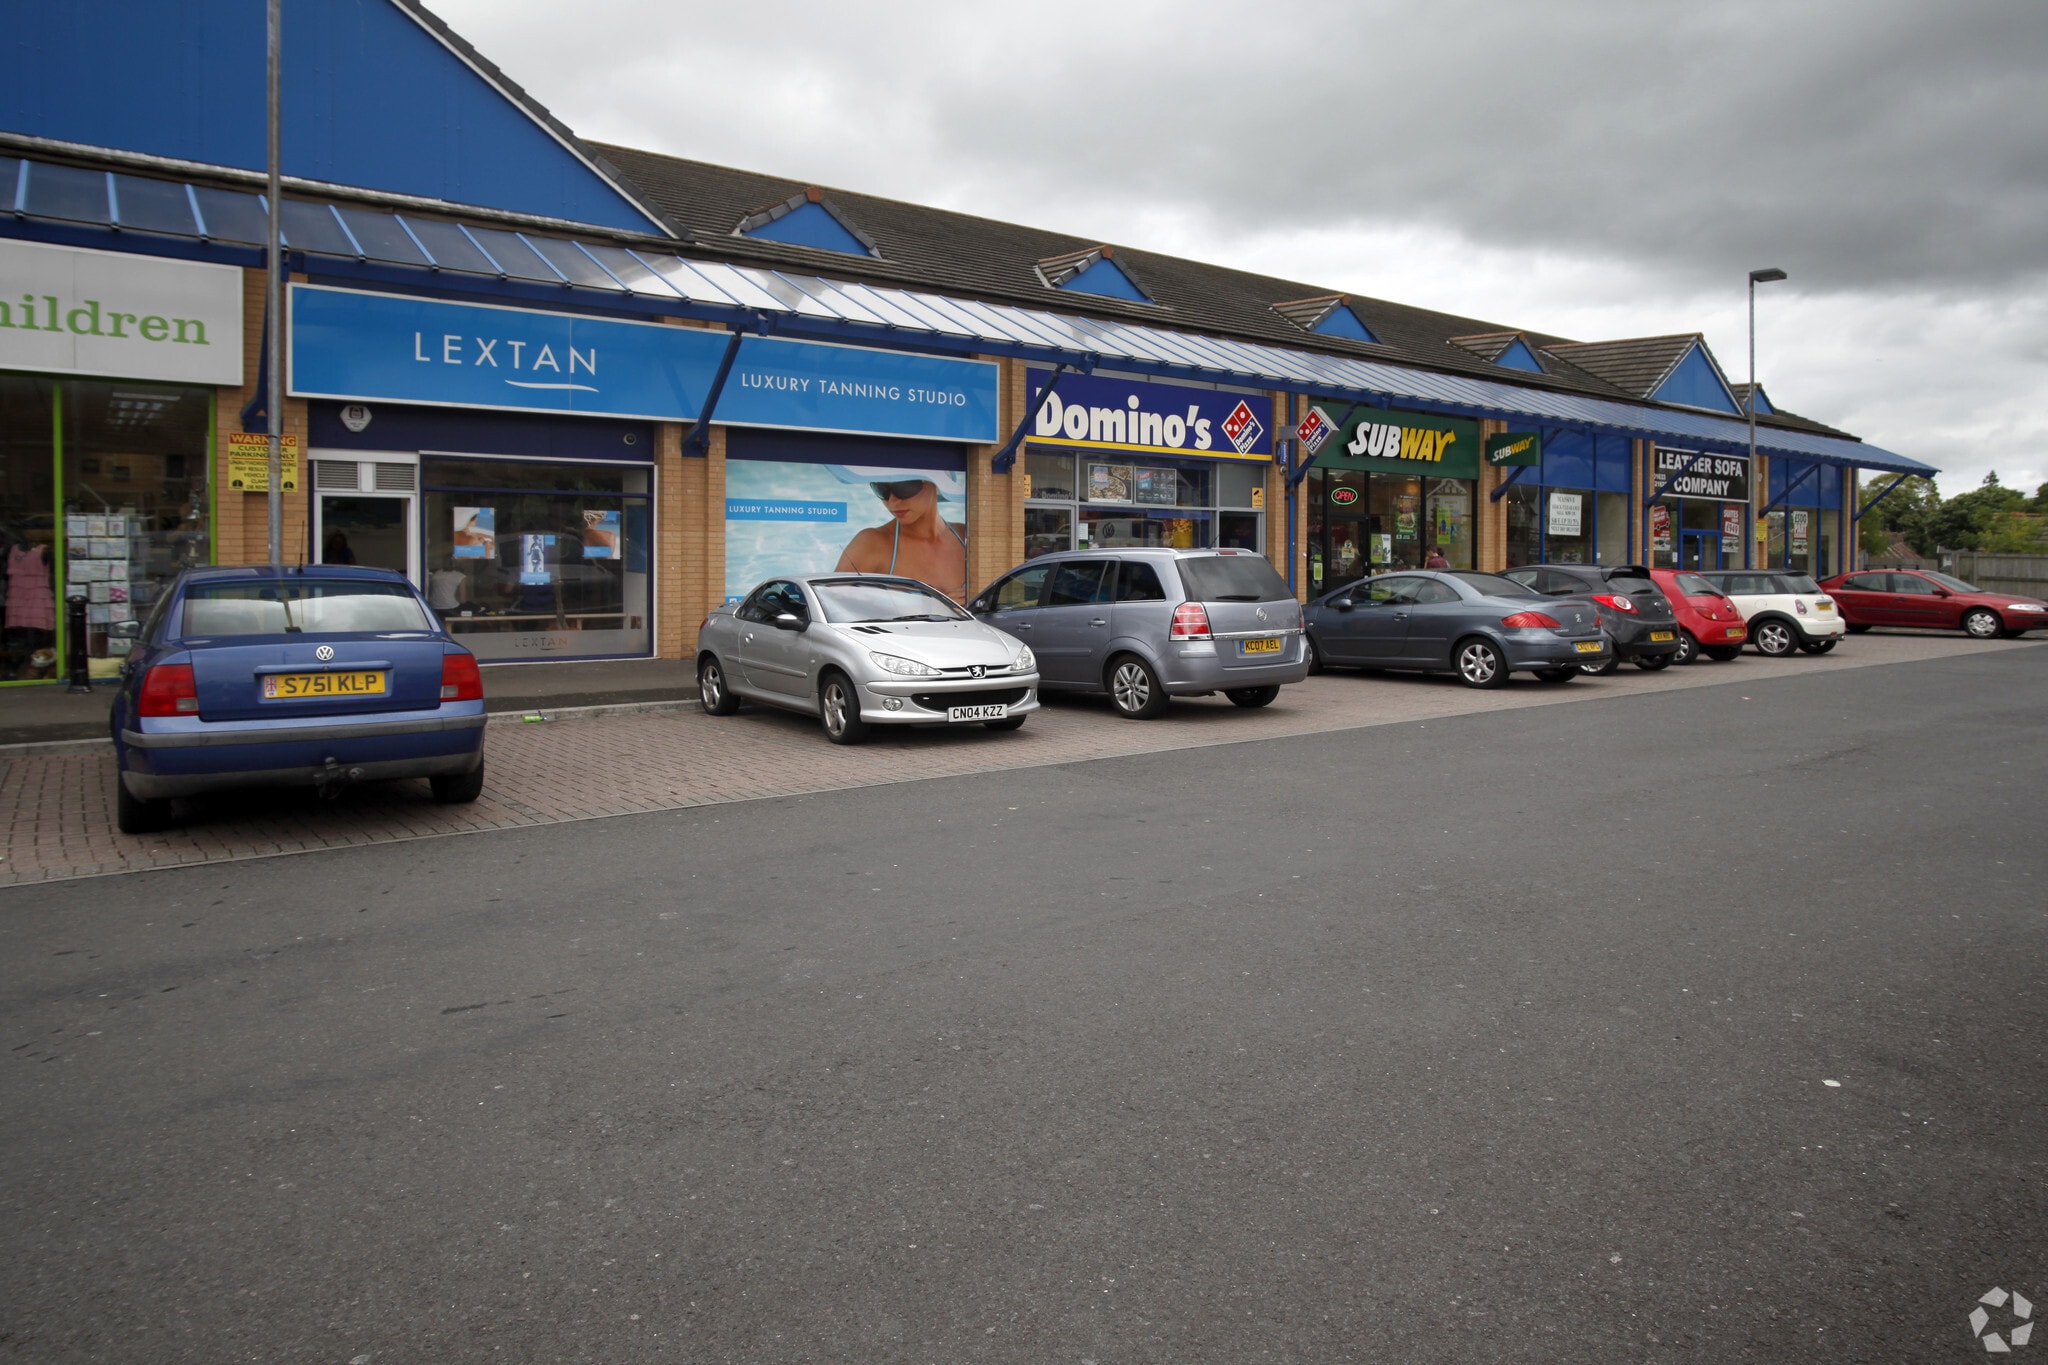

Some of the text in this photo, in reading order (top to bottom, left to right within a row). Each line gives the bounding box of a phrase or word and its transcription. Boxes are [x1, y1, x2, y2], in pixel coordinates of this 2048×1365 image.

[415, 331, 596, 376] LEXTAN
[742, 373, 966, 407] LUXURY TANNING STUDIO
[1036, 387, 1212, 450] Domino's
[231, 434, 296, 446] WARNNG
[1235, 421, 1256, 446] Domino's
[1347, 422, 1456, 462] SUBWAY
[238, 445, 288, 453] CUSTOR
[1240, 436, 1254, 453] Pizza
[1492, 436, 1534, 461] SUBWAY
[1714, 459, 1743, 477] SOFA
[1673, 476, 1729, 496] COMPANY
[1334, 490, 1354, 501] OPEN
[729, 505, 838, 515] LUXURY TANNING STUDIO
[514, 637, 570, 648] LEXTAN
[1245, 638, 1279, 651] KC07 AEL
[284, 674, 377, 694] S751 KLP
[952, 705, 1003, 719] CN04 KZZ
